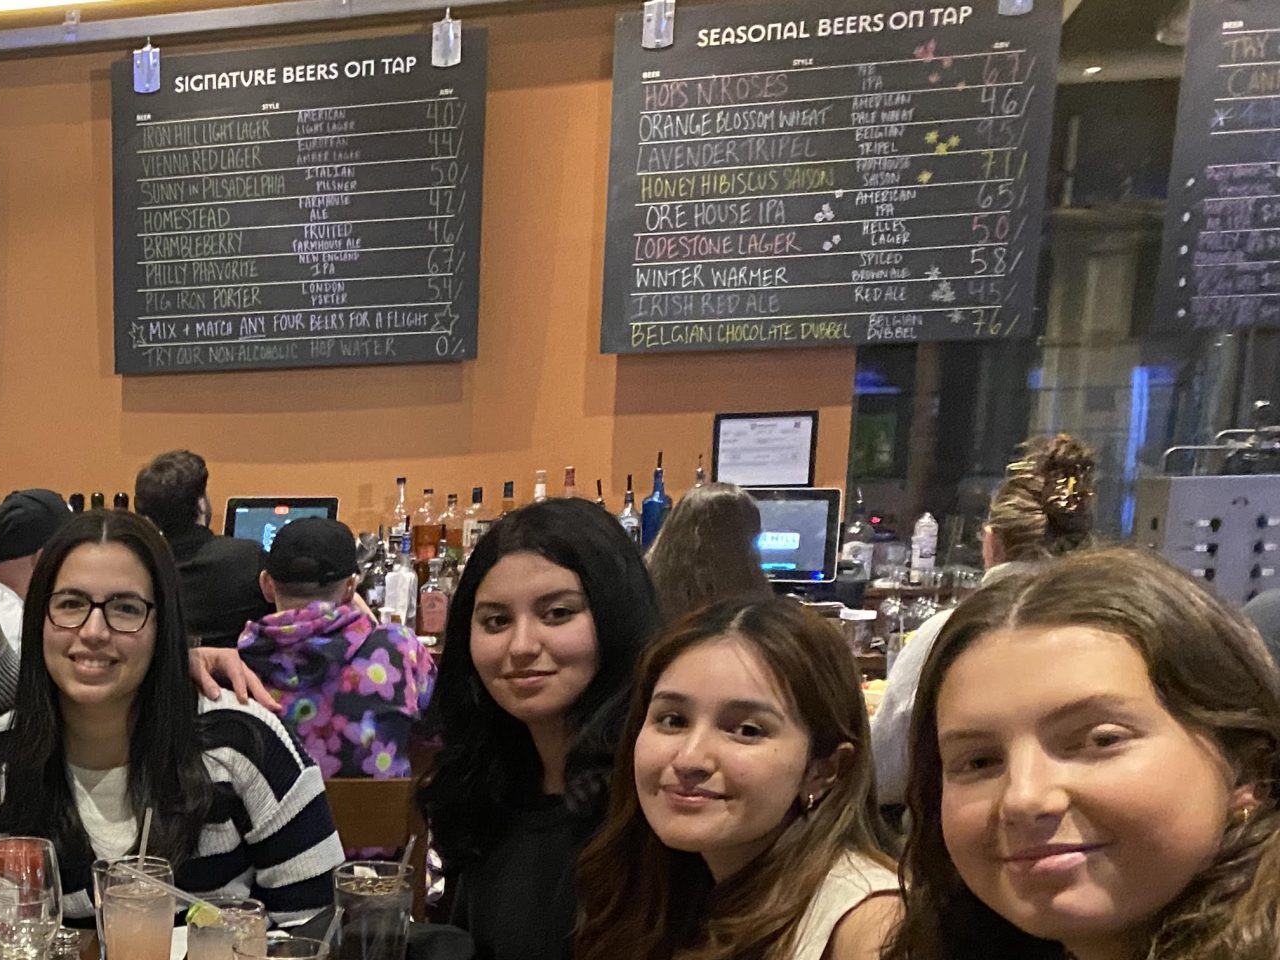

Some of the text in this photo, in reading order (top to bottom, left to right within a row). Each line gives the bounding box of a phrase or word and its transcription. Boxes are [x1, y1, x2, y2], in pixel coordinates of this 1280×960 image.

[696, 5, 973, 48] SEASONAL BEERS ON TAP
[174, 56, 417, 93] SIGNATURE BEERS ON TAP
[645, 82, 689, 111] HOPS
[721, 73, 790, 105] ROSES
[143, 118, 271, 149] IRON HILL LIGHT LAGER
[639, 104, 834, 142] ORANGE BLOSSOM WHEAT
[855, 126, 906, 142] BELGIAN
[141, 146, 264, 177] VIENNA RED LAGER
[636, 135, 818, 174] LAVENDER TRIPEL
[858, 142, 899, 156] TRIPEL
[304, 167, 355, 181] ITALIAN
[641, 167, 835, 200] HONEY HIBISCUS SAISON
[140, 181, 185, 205] SUNNY
[855, 188, 917, 206] AMERICAN
[143, 207, 231, 233] HOMESTEAD
[309, 208, 329, 222] ALE
[645, 199, 786, 232] ORE HOUSE IPA
[862, 219, 907, 236] HELLES
[304, 223, 353, 239] FRUITED
[871, 231, 911, 247] LAGER
[143, 231, 243, 260] BRAMBLEBERRY
[292, 238, 361, 253] FARMHOUSE ALE
[634, 231, 802, 262] LODESTONE LAGER
[145, 260, 260, 286] PHILLY PHAVORITE
[310, 262, 336, 277] IPA
[858, 252, 903, 268] SPICED
[302, 281, 345, 295] LONDON
[636, 264, 788, 289] WINTER WARMER
[145, 287, 262, 313] PIG IRON PORTER
[630, 292, 781, 320] IRISH RED ALE
[854, 286, 883, 302] RED
[149, 322, 177, 342] MIX
[195, 320, 233, 338] MATCH
[239, 316, 266, 338] ANY
[273, 312, 305, 332] FOUR
[309, 312, 345, 332] BEERS
[349, 311, 371, 329] FOR
[375, 311, 383, 329] A
[387, 311, 429, 328] FLIGHT
[868, 313, 923, 328] BELGIAN
[630, 323, 713, 348] BELGIAN
[717, 321, 798, 343] CHOCOLATE
[142, 347, 172, 368] TRY
[176, 347, 205, 365] OUR
[310, 337, 336, 358] HOP
[339, 337, 397, 357] WATER
